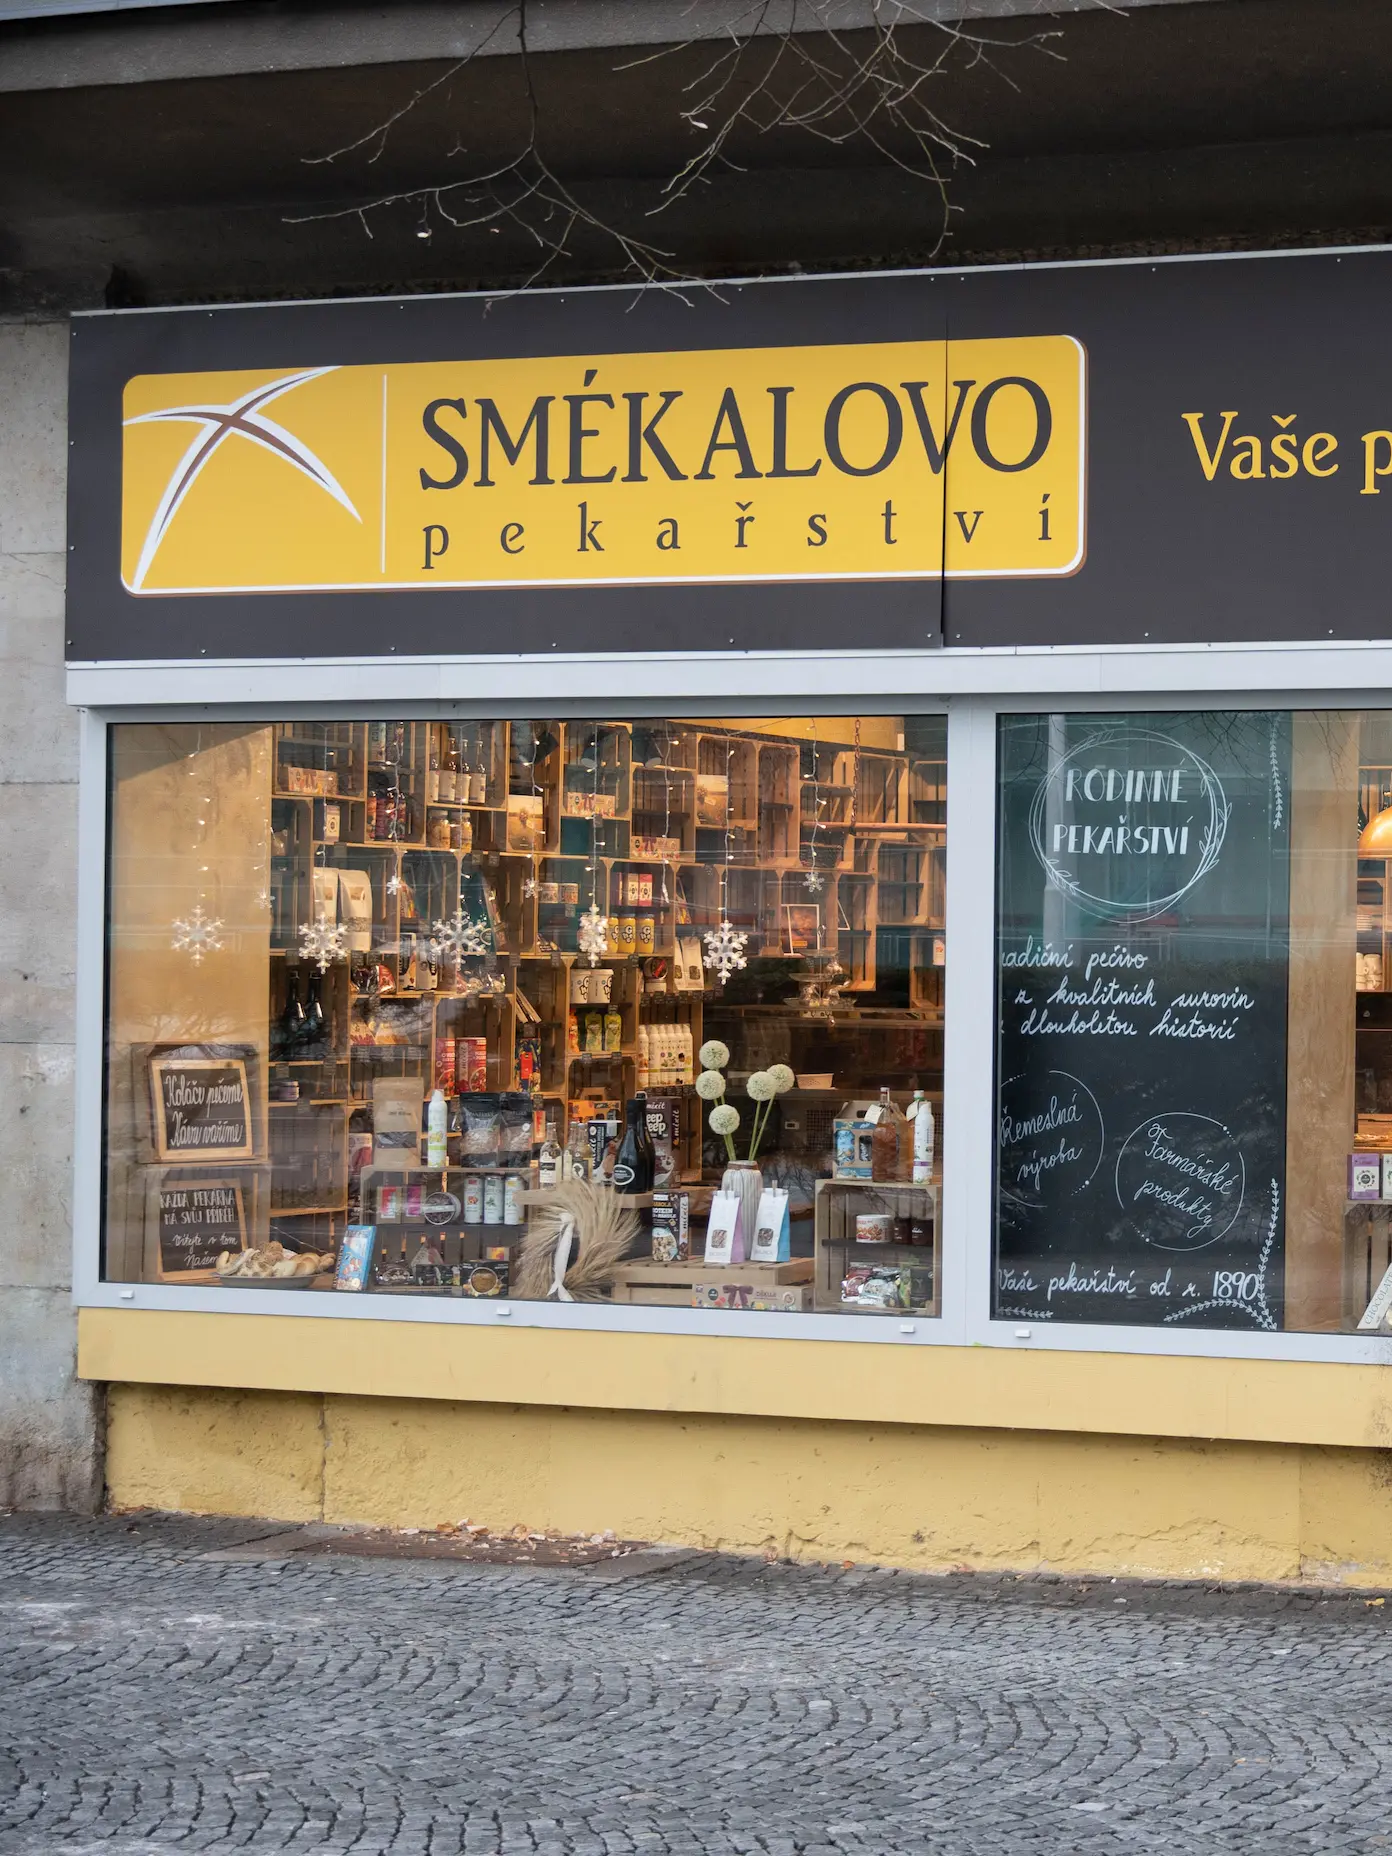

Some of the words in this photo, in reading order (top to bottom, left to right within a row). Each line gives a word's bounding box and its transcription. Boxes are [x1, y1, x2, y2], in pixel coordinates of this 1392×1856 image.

[419, 369, 1054, 490] SMÉKALOVO
[1180, 410, 1340, 482] Vaše
[421, 494, 1053, 570] pekařství
[1065, 757, 1188, 803] RODINNÉ
[1052, 814, 1194, 855] PEKAŘSTVÍ
[1084, 944, 1149, 982] pečivo
[1046, 975, 1157, 1008] kvalitních
[1170, 985, 1255, 1010] surovin
[1020, 1007, 1139, 1035] dlouholetou
[1149, 1007, 1240, 1040] historií
[1000, 1091, 1084, 1148] Řemeslná
[1016, 1137, 1083, 1191] výroba
[1144, 1122, 1239, 1196] Farmářské
[1133, 1179, 1213, 1239] produkty
[999, 1268, 1040, 1292] Vaše
[1046, 1261, 1137, 1301] pekařství
[1149, 1267, 1172, 1297] od
[1211, 1270, 1260, 1301] 1890
